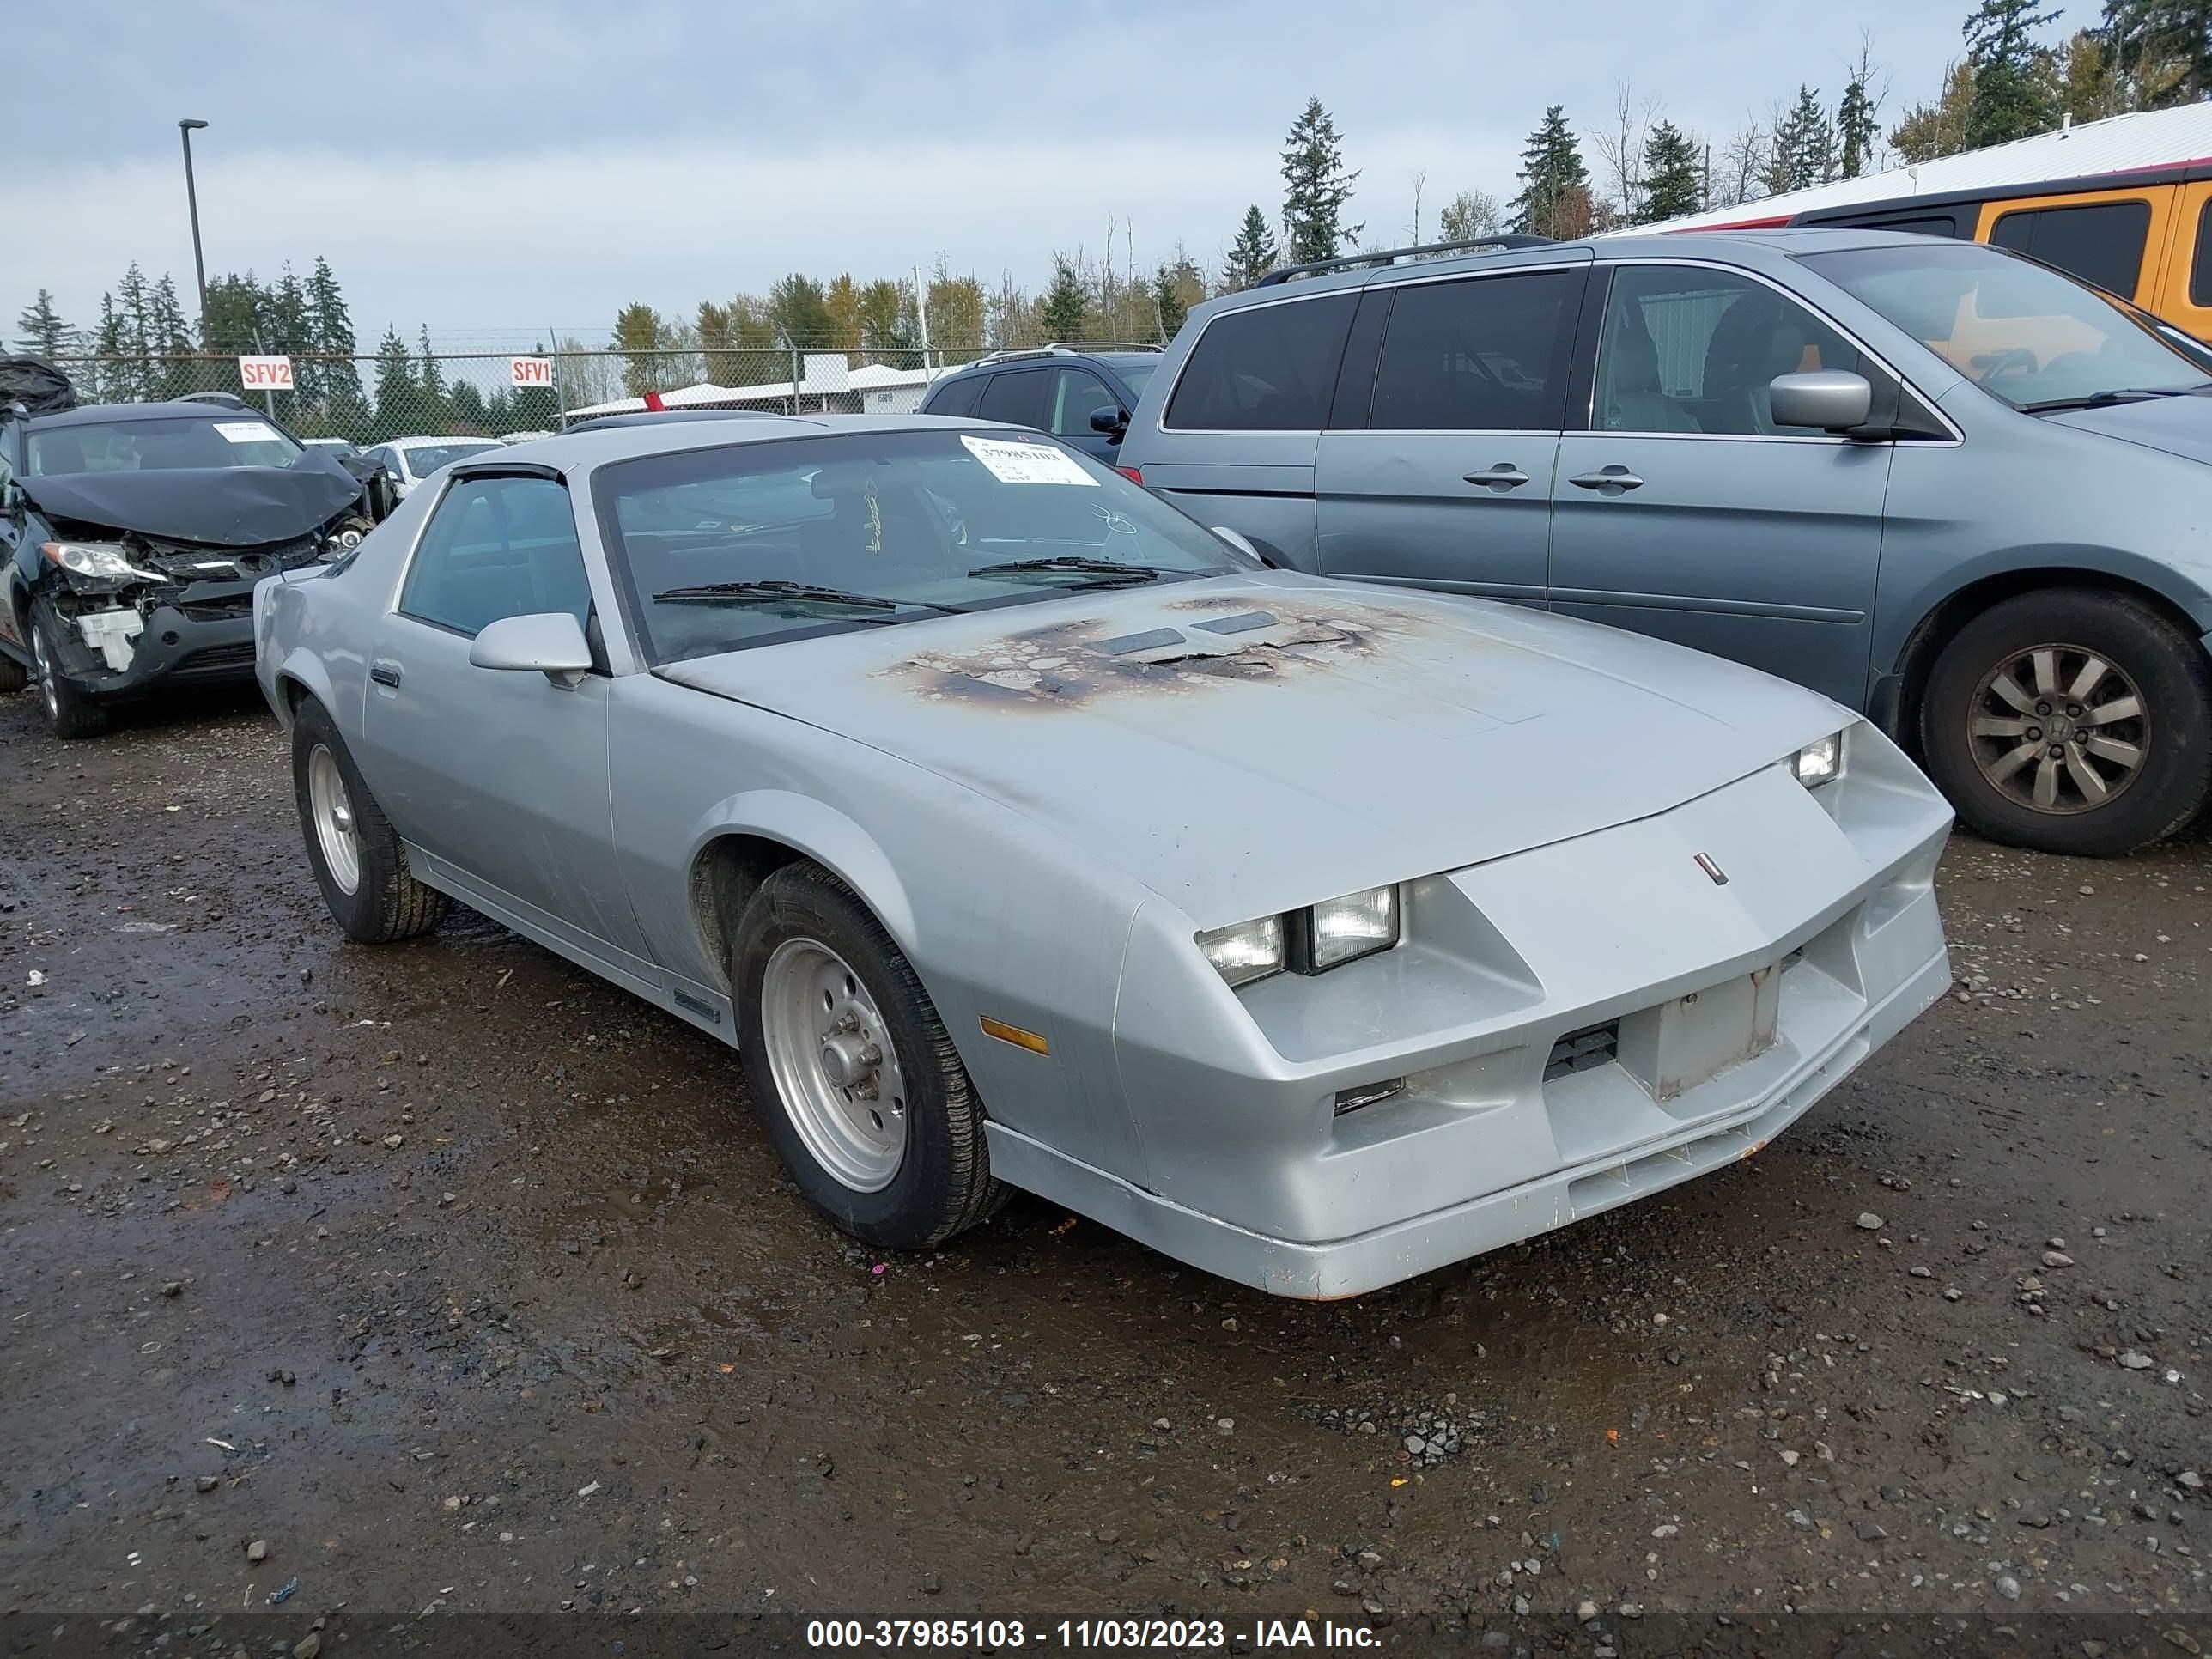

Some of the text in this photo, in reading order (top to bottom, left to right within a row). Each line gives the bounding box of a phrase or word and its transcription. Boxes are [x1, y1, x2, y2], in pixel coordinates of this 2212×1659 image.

[243, 363, 292, 384] SFV2
[514, 362, 550, 382] SFV1
[981, 447, 1061, 461] 37985103
